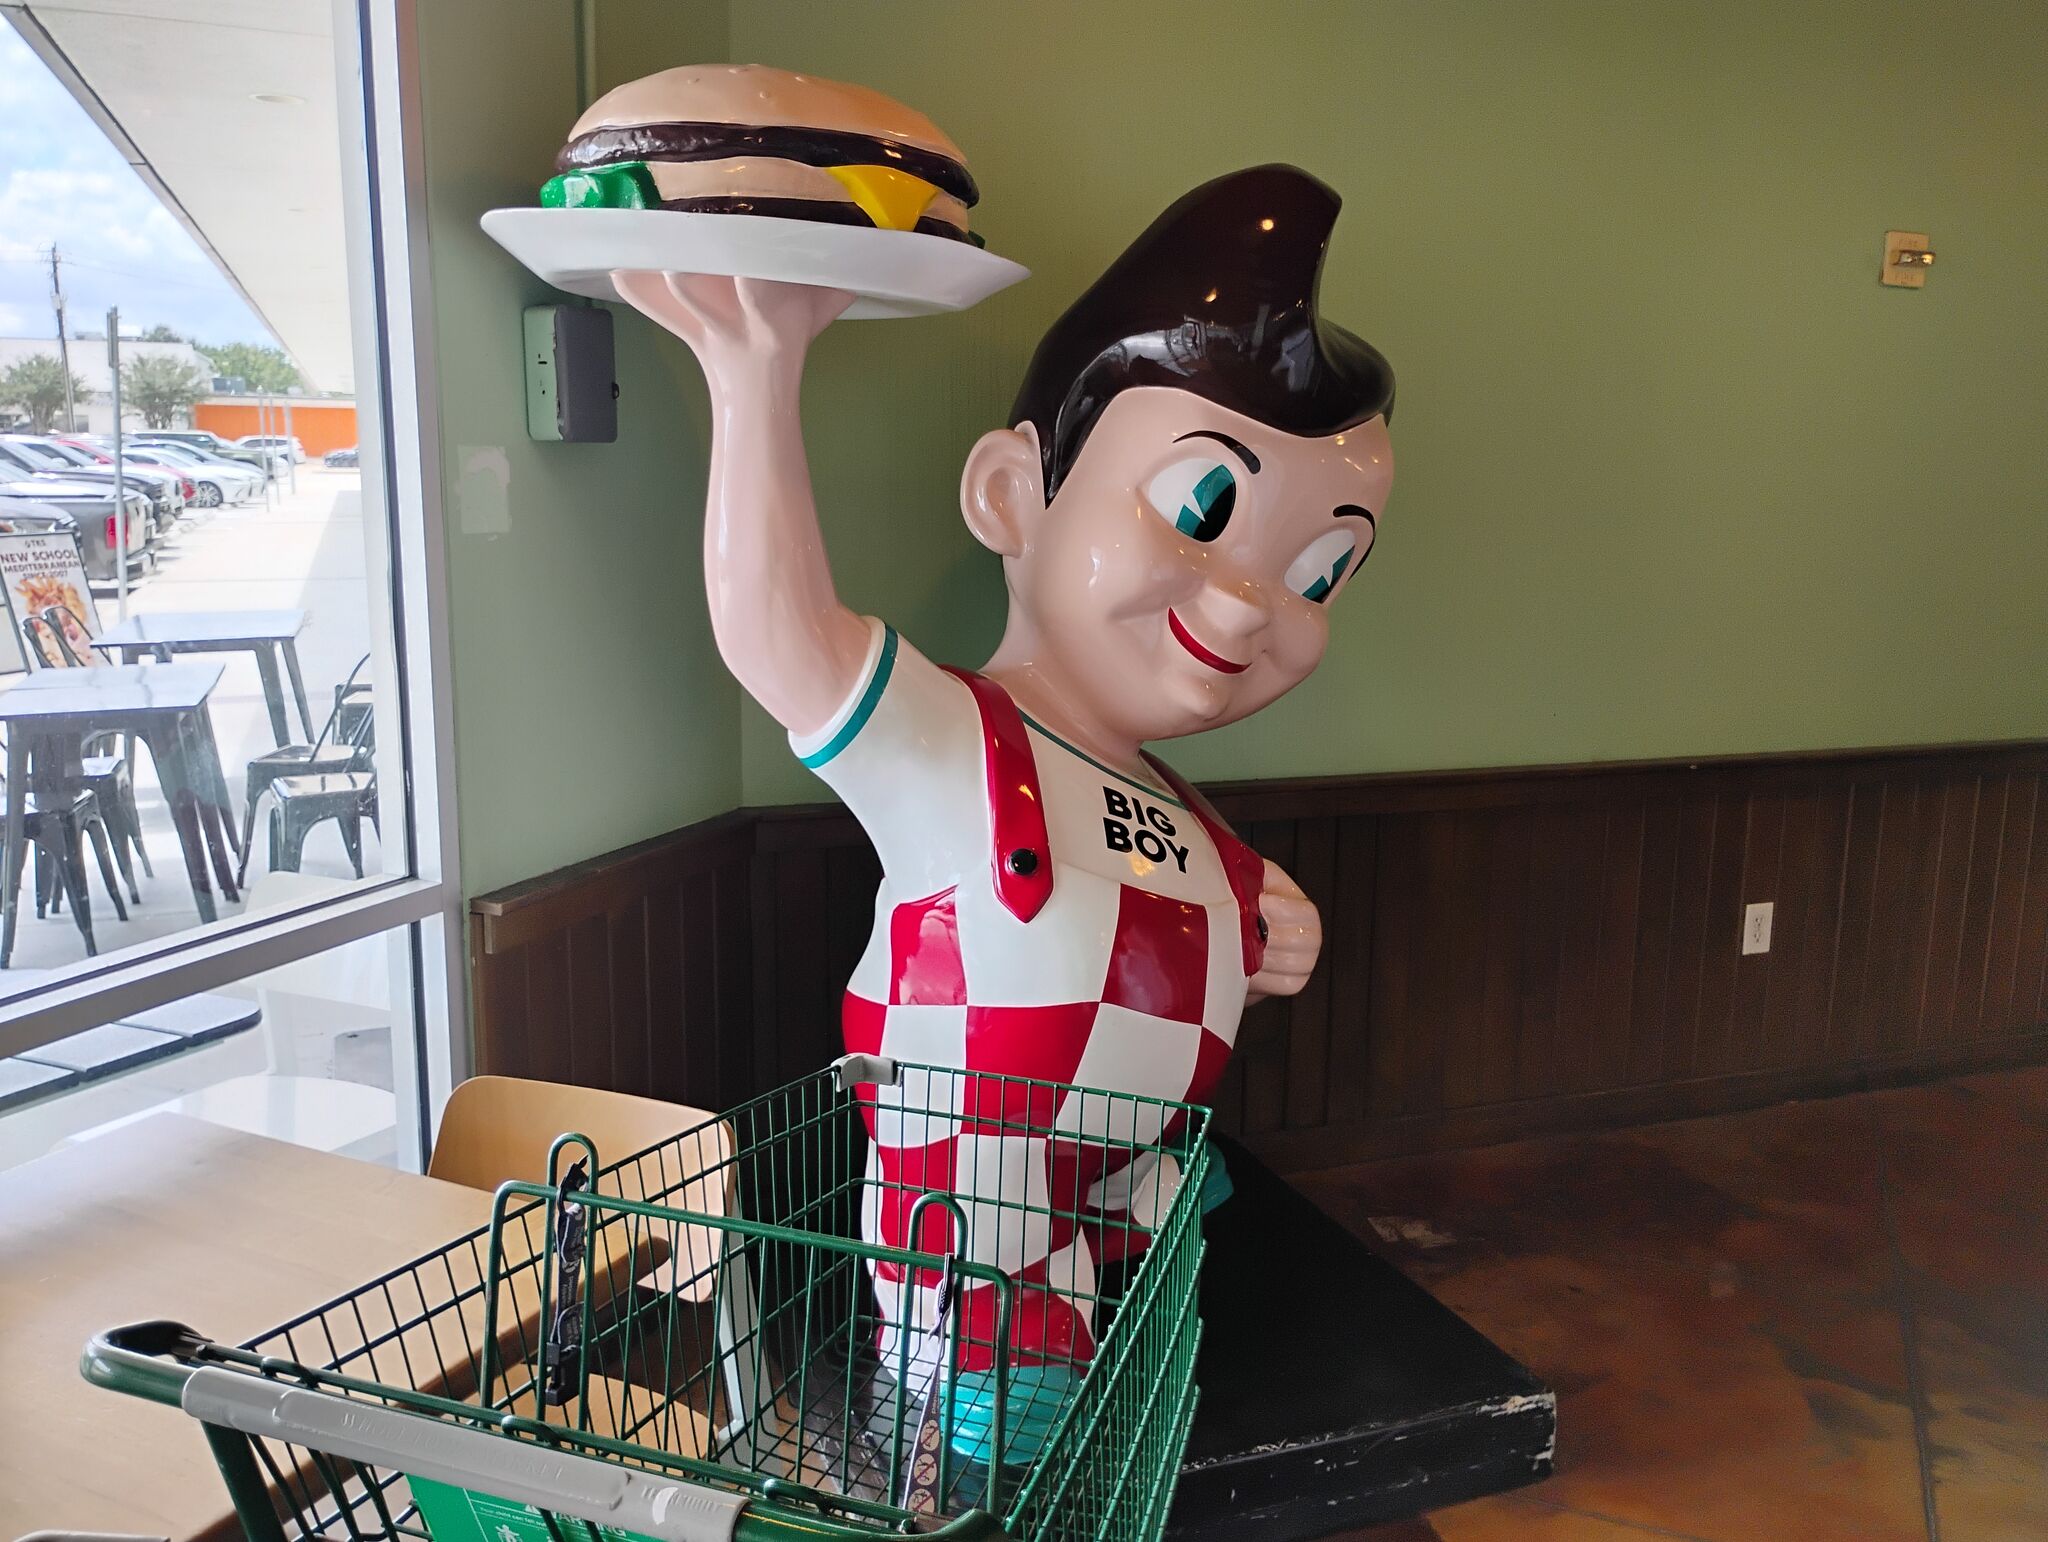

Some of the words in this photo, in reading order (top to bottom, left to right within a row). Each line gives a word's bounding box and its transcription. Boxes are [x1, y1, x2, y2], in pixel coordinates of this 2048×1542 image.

[0, 552, 28, 563] NEW
[32, 549, 78, 560] SCHOOL
[4, 561, 80, 573] MEDITERRANEAN
[1103, 786, 1176, 836] BIG
[1103, 817, 1189, 873] BOY
